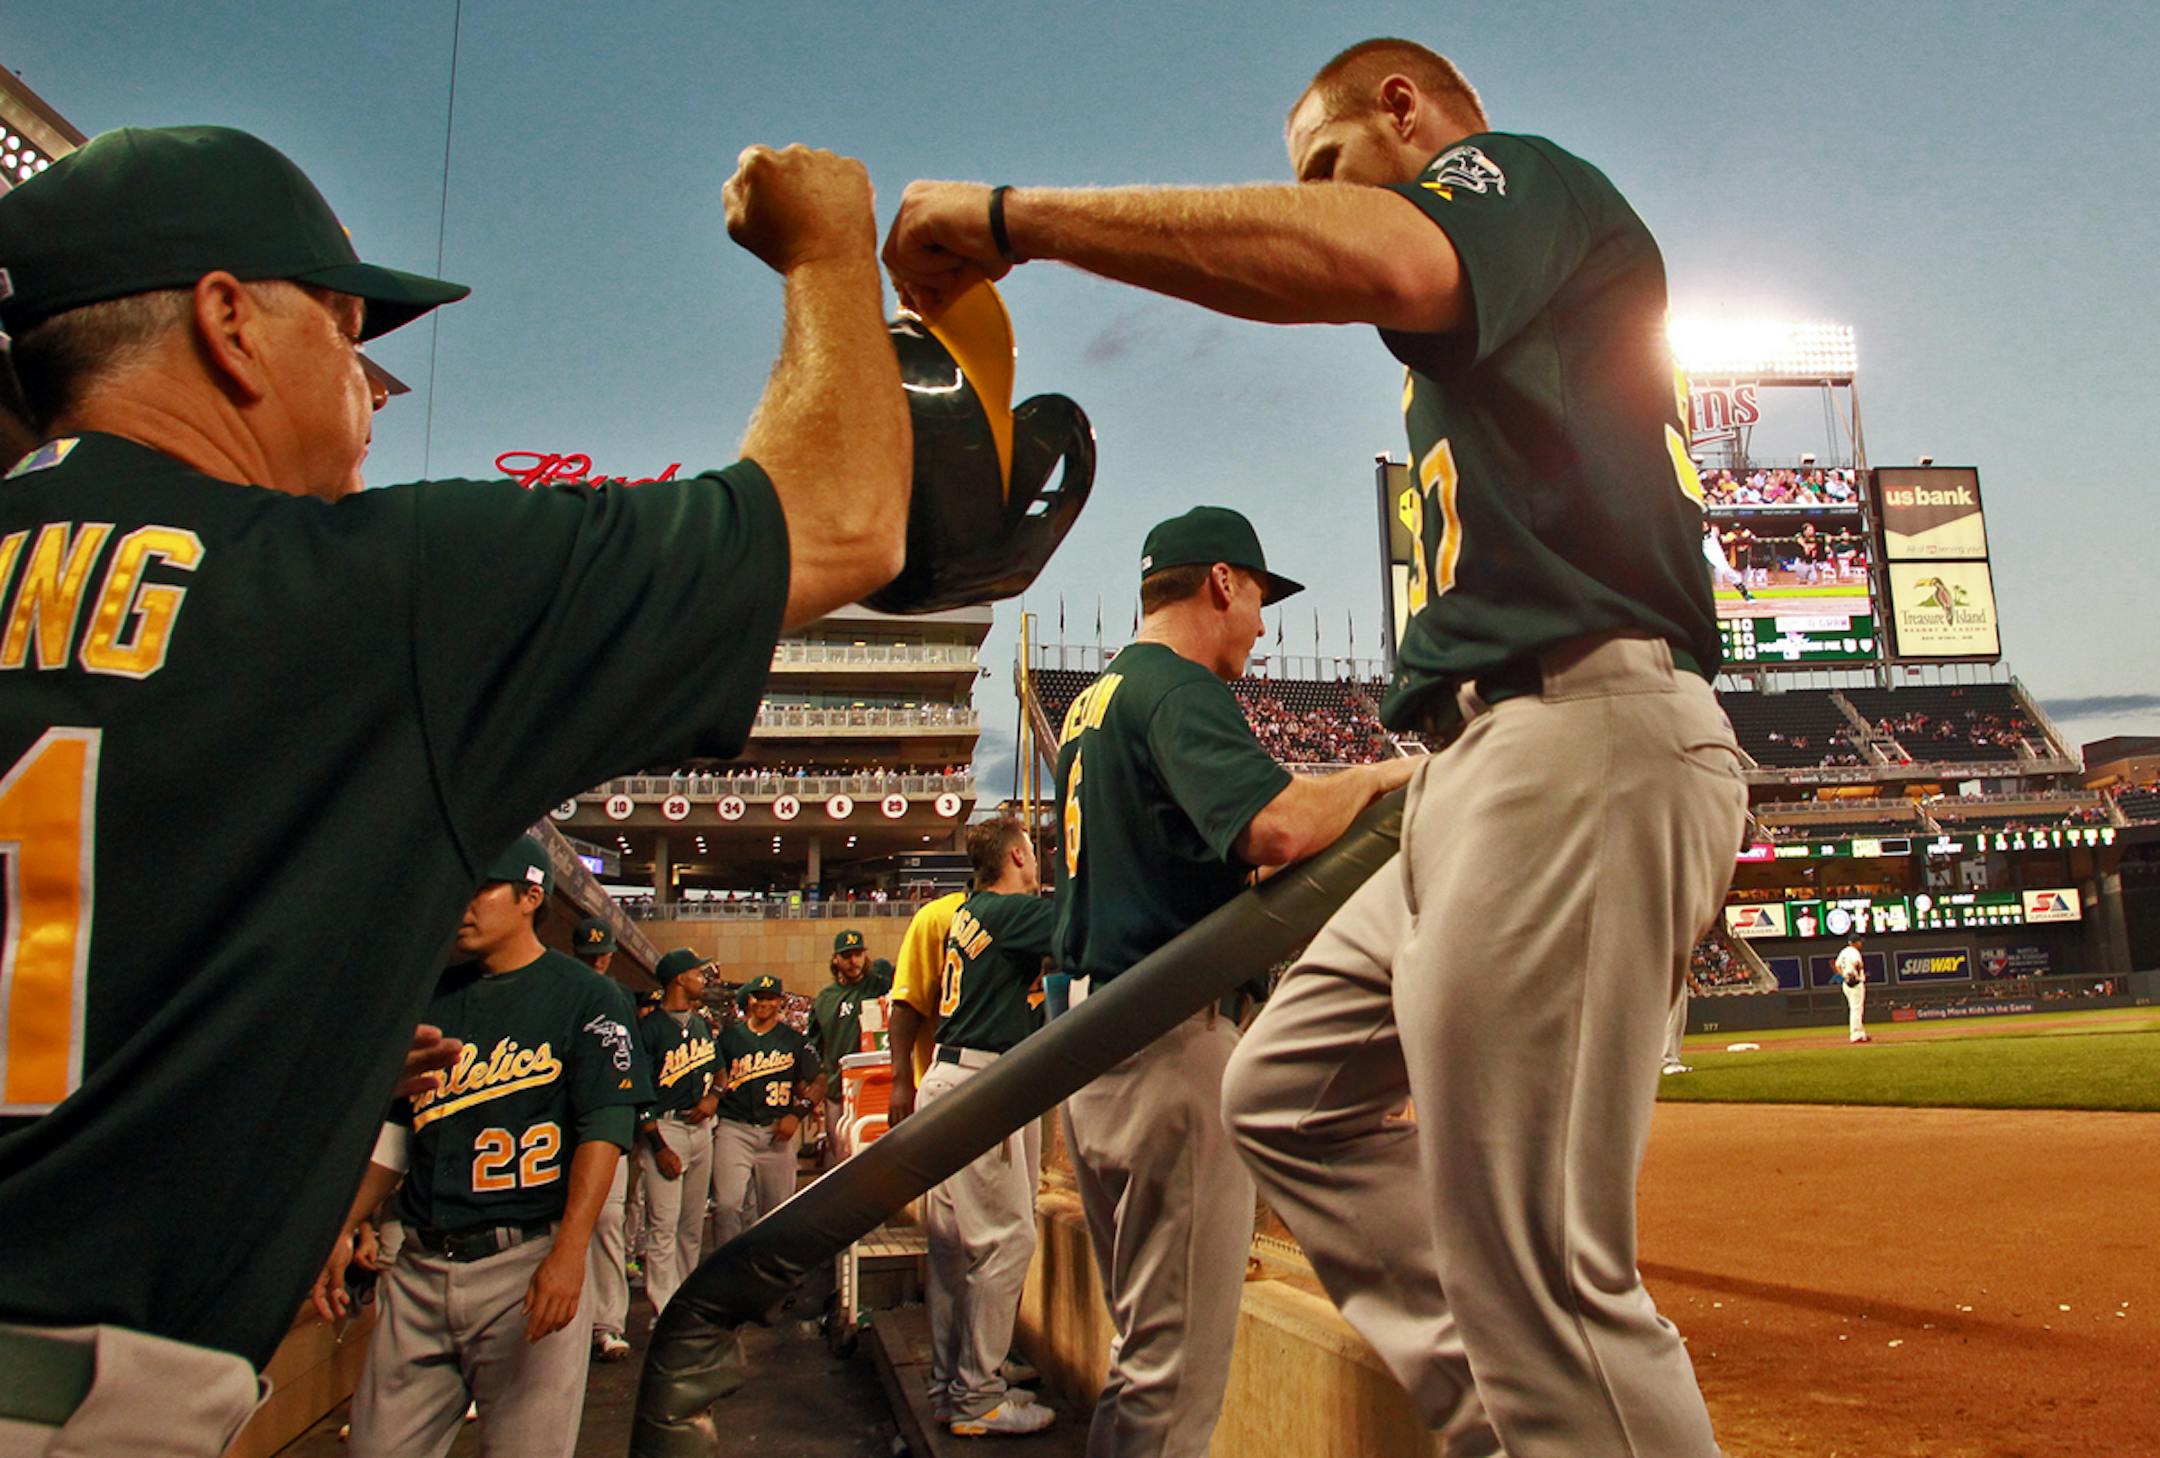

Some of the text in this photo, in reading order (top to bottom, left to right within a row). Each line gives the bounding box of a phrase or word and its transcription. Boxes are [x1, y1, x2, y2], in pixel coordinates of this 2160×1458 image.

[1955, 608, 1987, 624] Island
[948, 909, 993, 961] SON
[1901, 955, 1966, 976] SUBWAY
[1917, 1008, 1947, 1018] Getting
[1947, 1007, 1967, 1016] More
[1968, 1006, 1985, 1015] Kids
[2009, 1003, 2033, 1012] Game
[729, 1050, 795, 1082] Athletics
[765, 1081, 793, 1107] 35
[471, 1121, 562, 1193] 22
